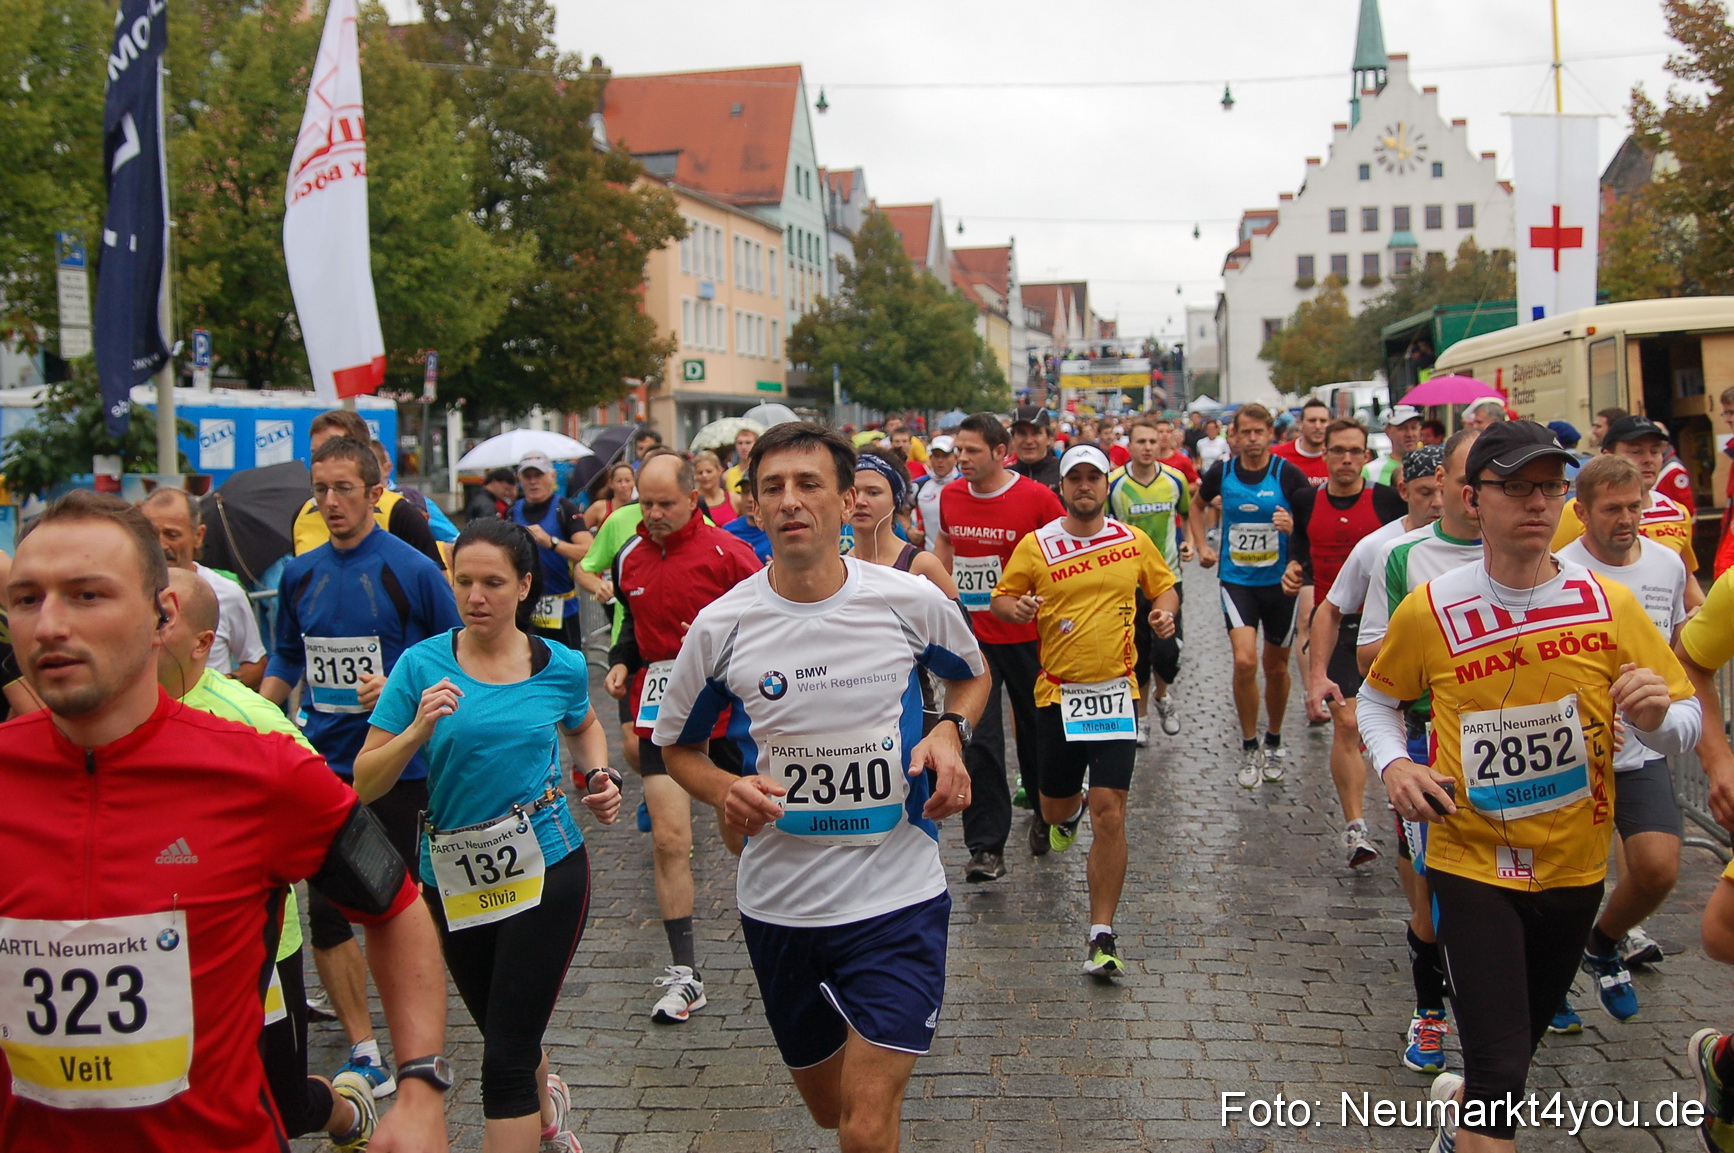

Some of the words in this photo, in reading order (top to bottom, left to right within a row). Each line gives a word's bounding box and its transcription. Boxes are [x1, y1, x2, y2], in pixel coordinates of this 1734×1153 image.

[685, 361, 703, 379] D
[200, 424, 234, 448] DIXI
[256, 424, 294, 448] DIXI
[949, 526, 1004, 539] NEUMARKT
[1238, 534, 1267, 550] 271
[1051, 561, 1093, 583] MAX
[1097, 545, 1141, 568] BÖGL
[956, 570, 998, 590] 2379
[1454, 646, 1530, 685] MAX
[1536, 631, 1617, 662] BÖGL
[313, 656, 374, 685] 3133
[795, 666, 828, 680] BMW
[797, 680, 827, 693] Werk
[831, 672, 897, 689] Regensburg
[1069, 692, 1125, 718] 2907
[1082, 720, 1120, 732] Michael
[1463, 722, 1500, 735] PARTL
[1503, 713, 1563, 731] Neumarkt
[771, 746, 813, 758] PARTL
[816, 742, 877, 757] Neumarkt
[1473, 726, 1577, 781] 2852
[784, 758, 892, 805] 2340
[1505, 781, 1557, 805] Stefan
[809, 816, 870, 832] Johann
[431, 843, 464, 854] PARTL
[465, 831, 514, 850] Neumarkt
[156, 854, 198, 864] adidas
[455, 845, 525, 887] 132
[478, 889, 516, 909] Silvia
[48, 936, 148, 957] Neumarkt
[23, 964, 149, 1036] 323
[59, 1055, 113, 1082] Veit
